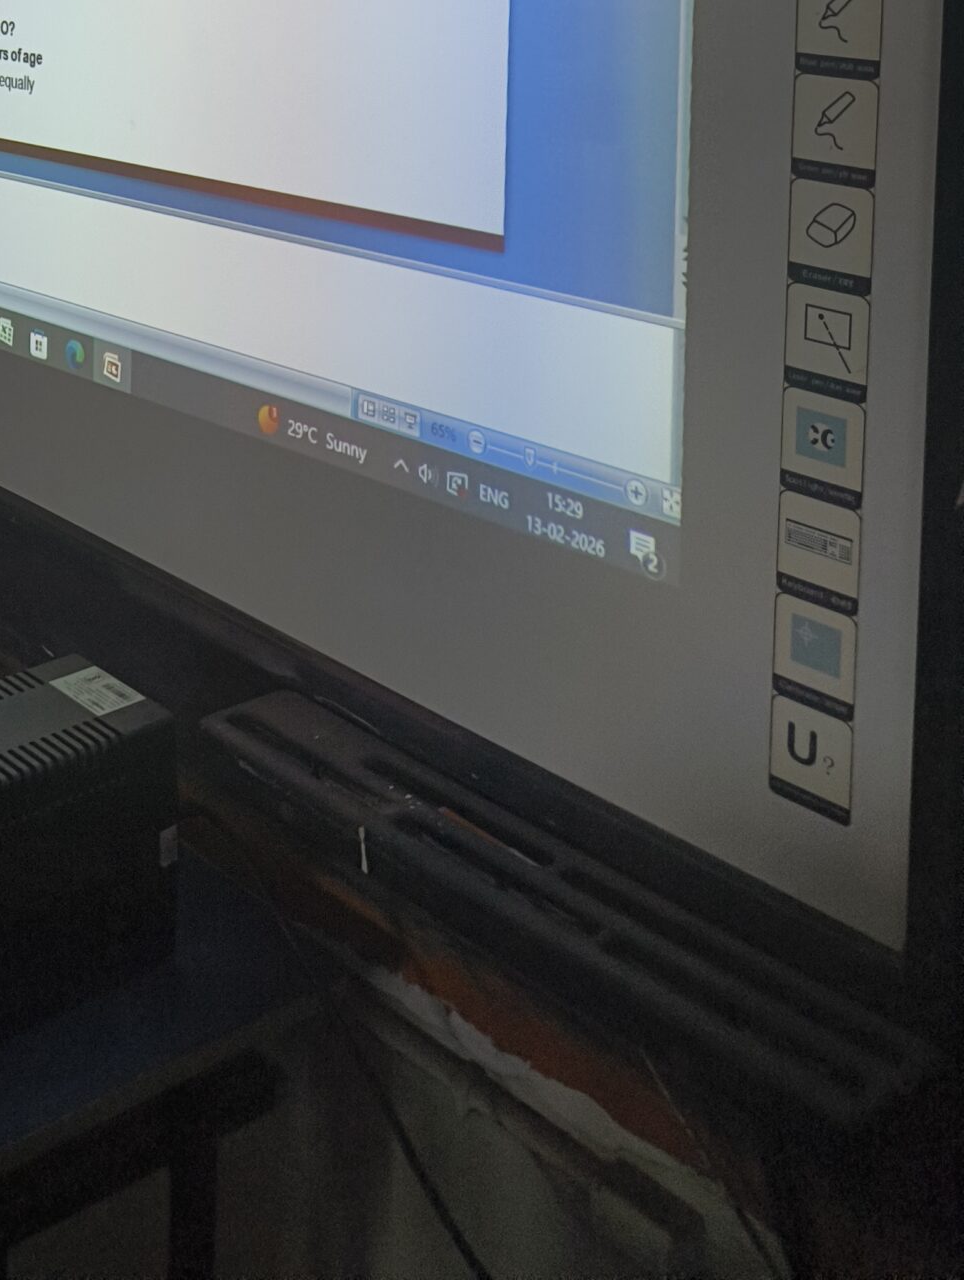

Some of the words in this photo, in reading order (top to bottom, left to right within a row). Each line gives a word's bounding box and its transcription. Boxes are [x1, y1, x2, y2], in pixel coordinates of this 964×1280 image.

[10, 47, 23, 63] of
[23, 51, 43, 68] age
[287, 419, 318, 445] 29°C
[325, 432, 367, 464] Sunny
[479, 483, 509, 510] ENG
[546, 491, 584, 519] 15:29
[525, 514, 606, 558] 13-02-2026
[646, 554, 658, 573] 2
